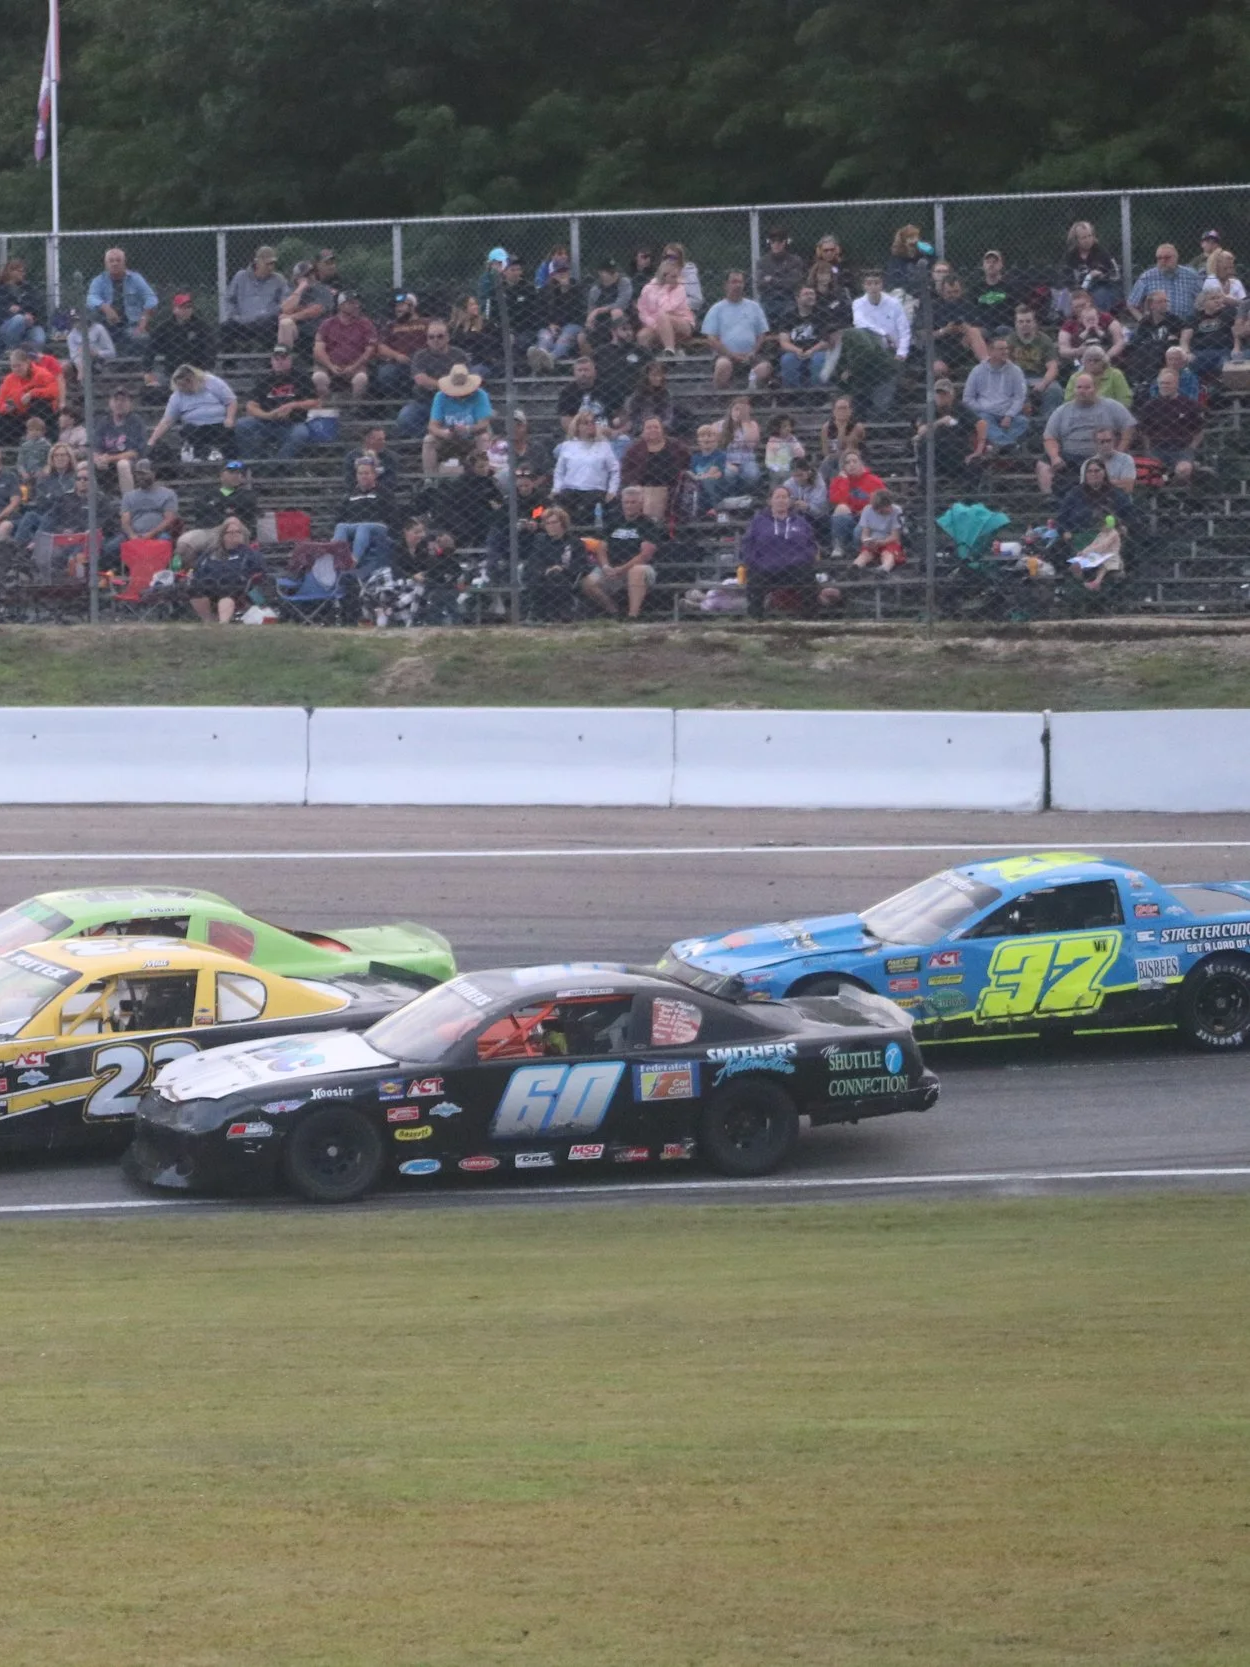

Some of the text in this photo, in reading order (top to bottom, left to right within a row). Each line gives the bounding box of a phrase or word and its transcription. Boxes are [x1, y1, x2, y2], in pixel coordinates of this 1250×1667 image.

[1160, 925, 1220, 943] STREETER
[1187, 939, 1247, 953] GET A LOAD OF
[10, 952, 69, 979] POTTER
[928, 951, 962, 967] ACT
[973, 930, 1123, 1025] 37
[13, 1051, 49, 1068] ACT
[706, 1042, 798, 1061] SMITHERS
[820, 1045, 840, 1059] The
[640, 1061, 691, 1073] Federated
[829, 1051, 882, 1071] SHUTTLE
[406, 1077, 445, 1098] ACT
[667, 1086, 690, 1095] Care
[672, 1078, 690, 1087] Car
[828, 1075, 909, 1096] CONNECTION
[310, 1086, 354, 1100] Hoosier
[491, 1061, 626, 1138] 60
[572, 1146, 602, 1154] MSD
